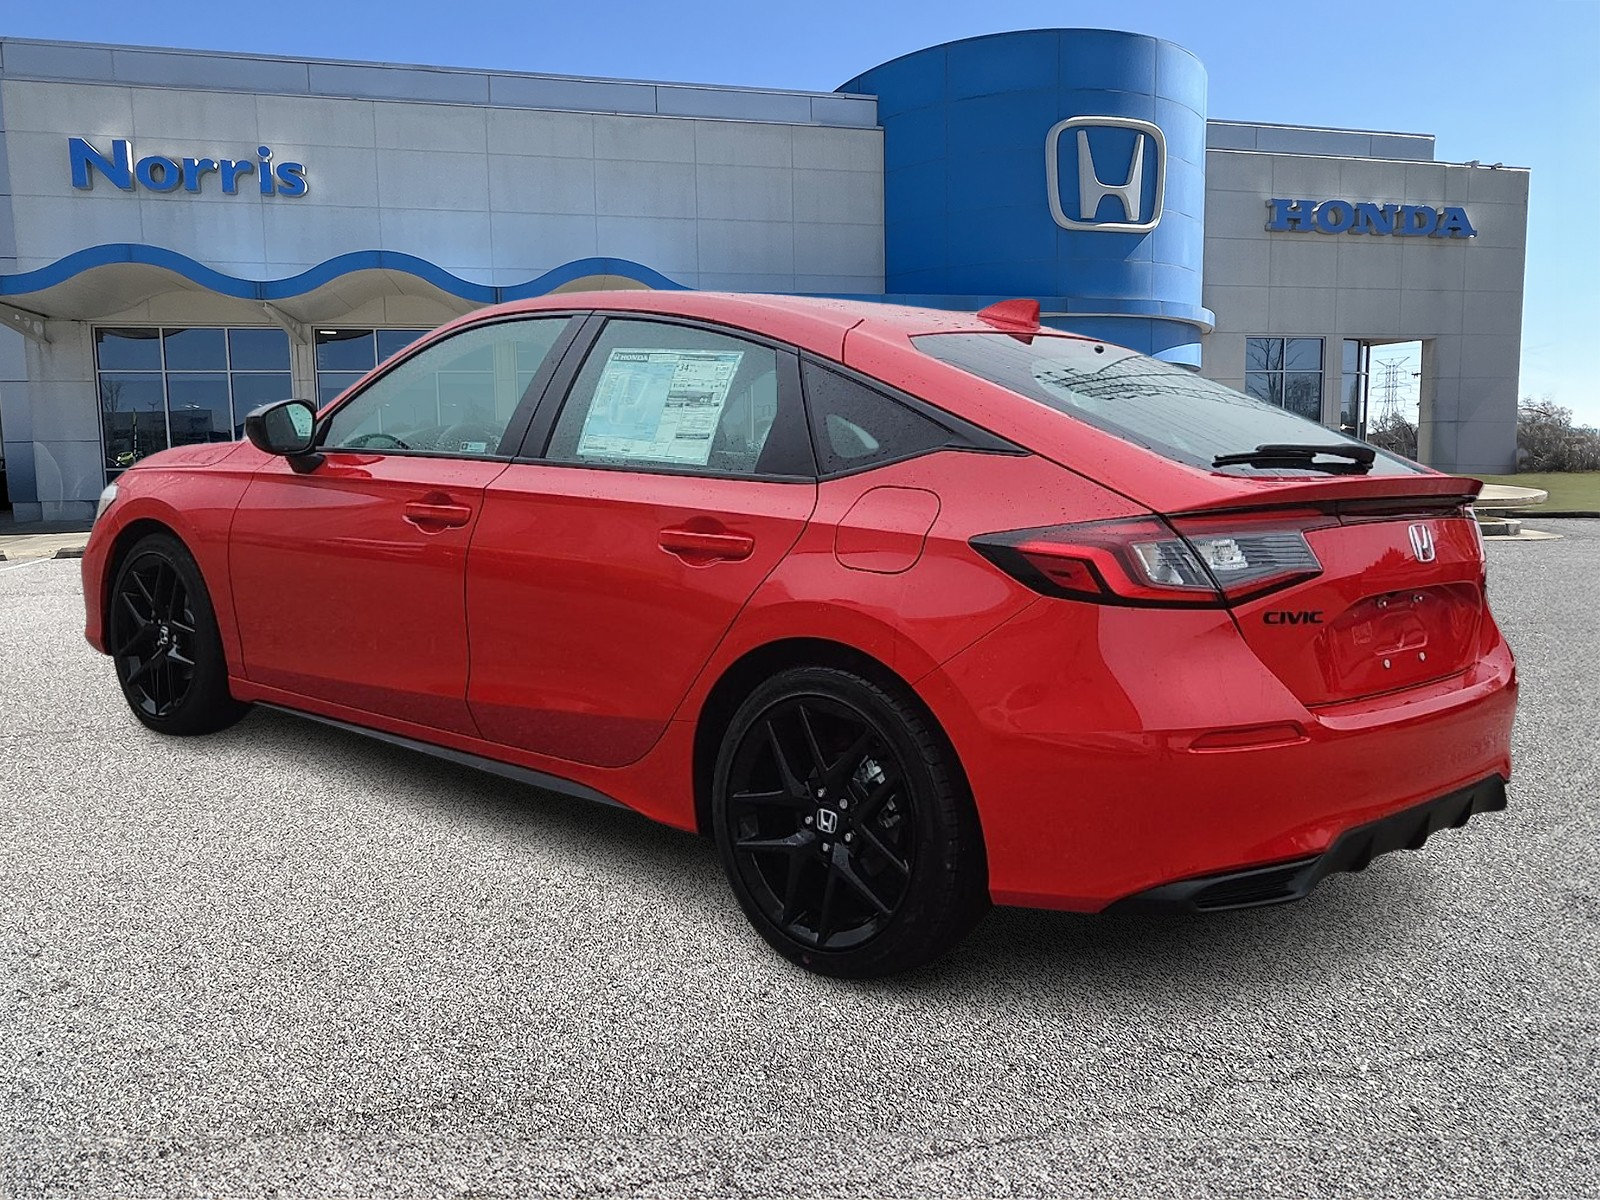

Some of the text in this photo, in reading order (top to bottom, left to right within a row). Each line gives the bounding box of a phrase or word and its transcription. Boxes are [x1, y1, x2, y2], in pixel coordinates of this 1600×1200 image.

[68, 137, 308, 197] Norris
[1265, 198, 1478, 239] HONDA
[1262, 611, 1324, 625] CIVIC
